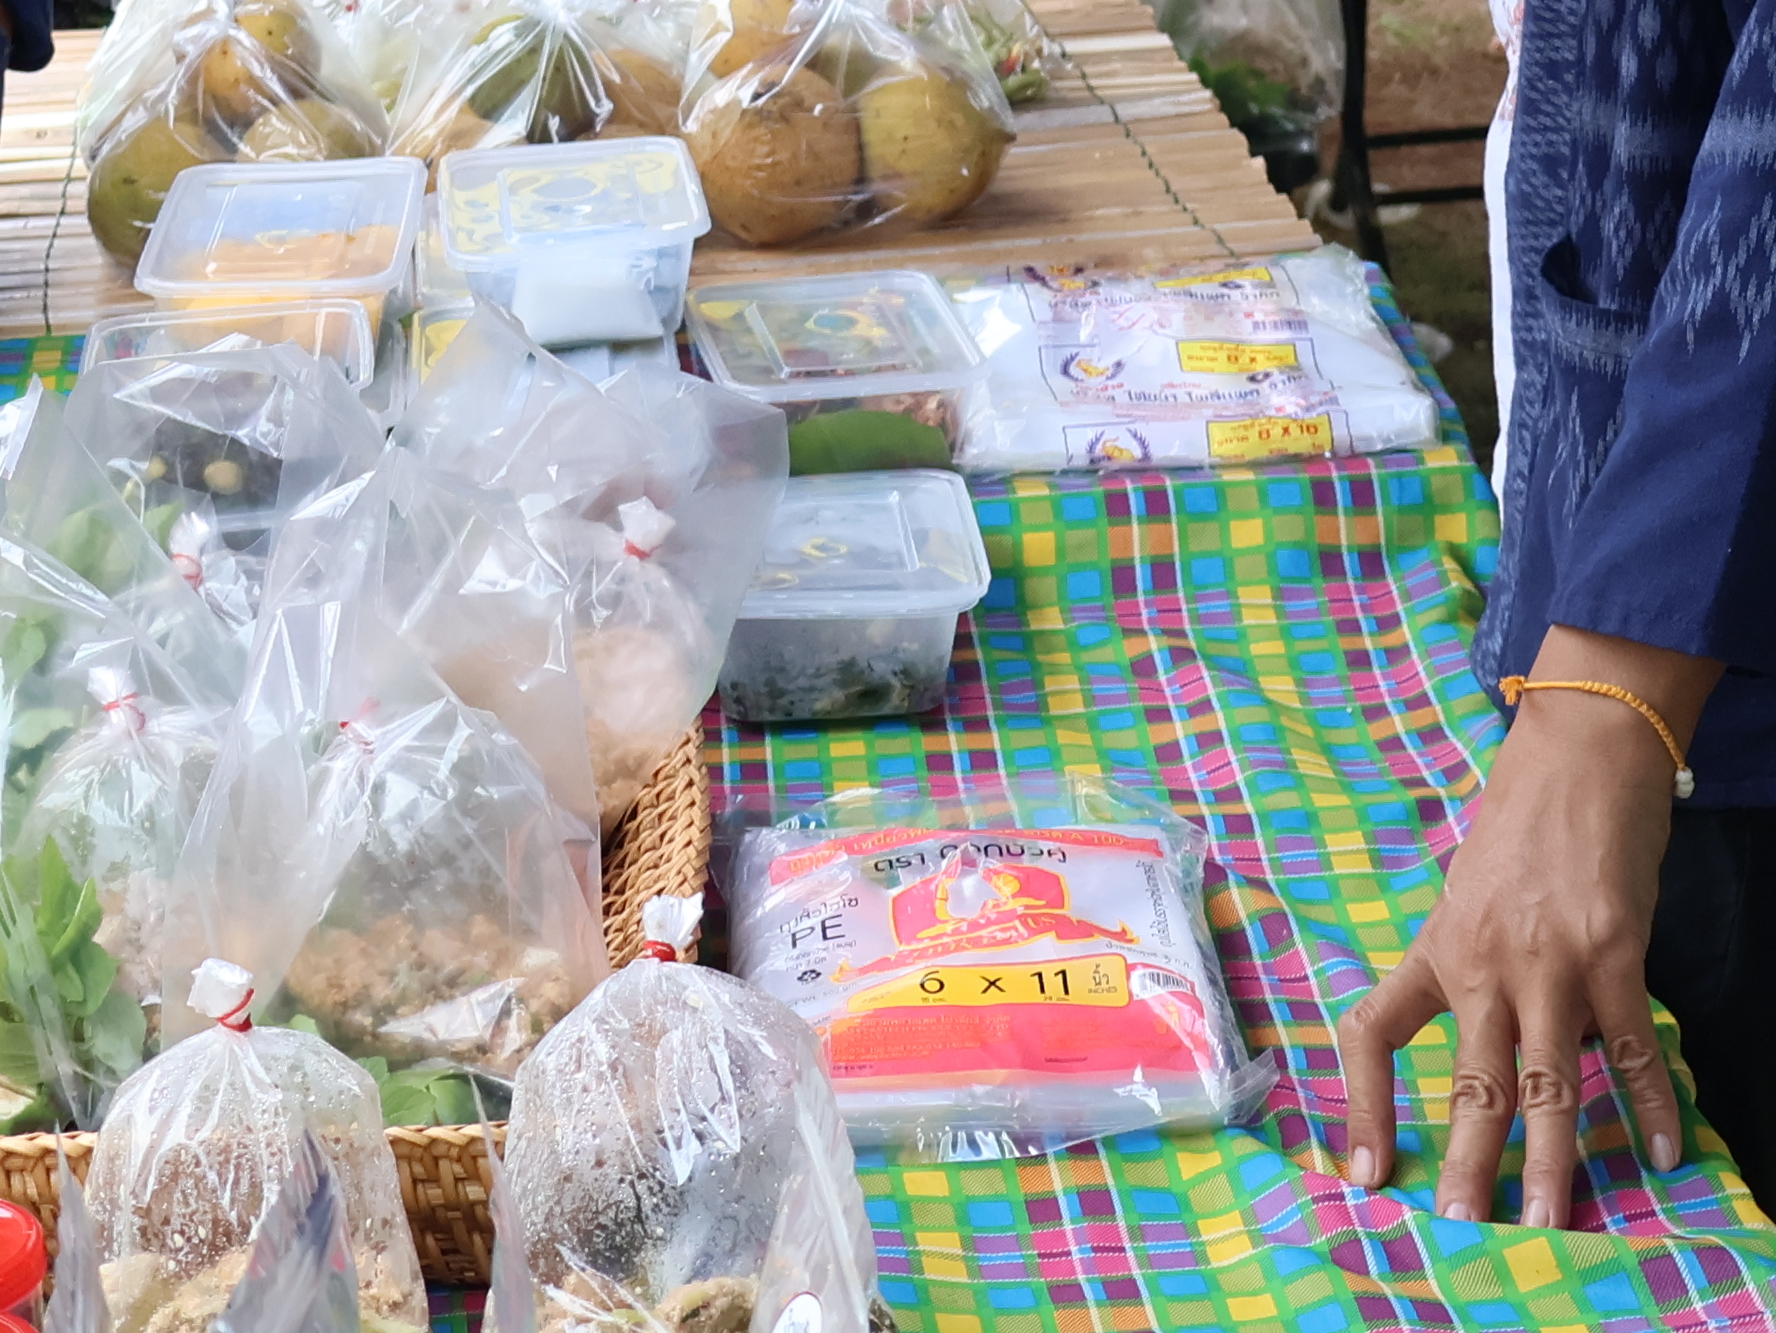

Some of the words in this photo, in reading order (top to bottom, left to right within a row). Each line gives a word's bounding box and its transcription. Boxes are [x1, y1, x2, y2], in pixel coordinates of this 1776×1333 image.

[874, 851, 926, 873] ตรา
[791, 913, 846, 950] PE
[919, 970, 946, 995] 6
[1029, 968, 1070, 997] 11
[1091, 963, 1111, 988] นิ้ว
